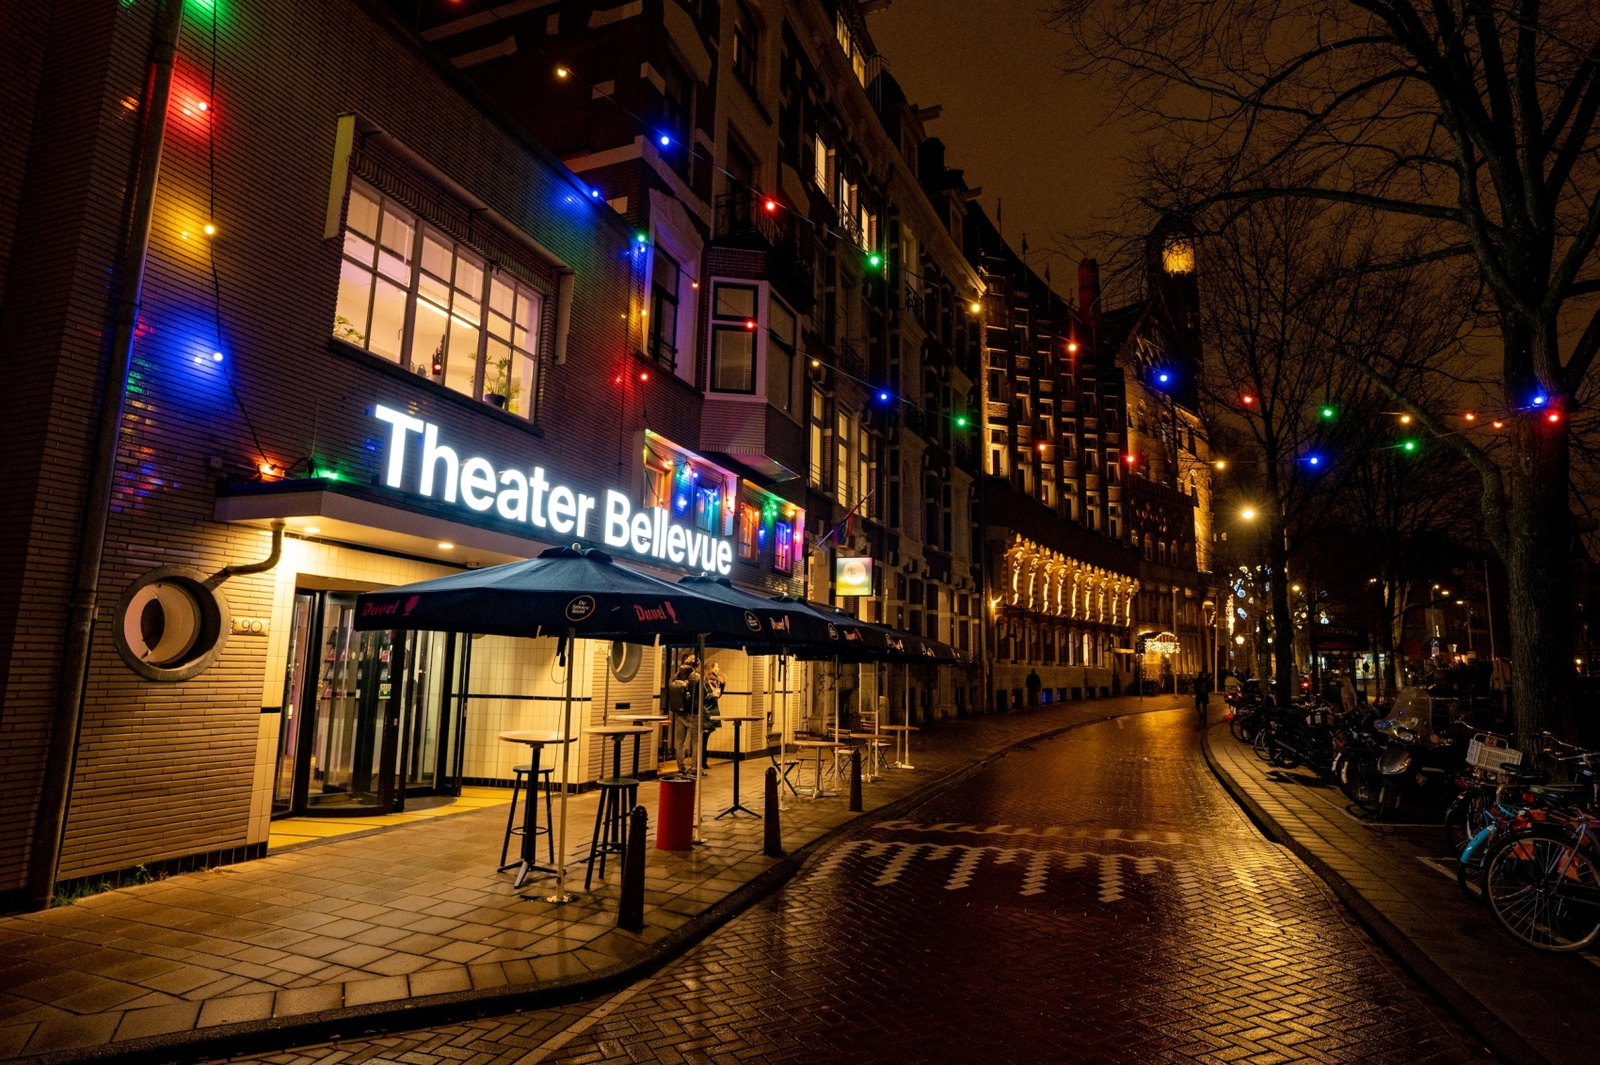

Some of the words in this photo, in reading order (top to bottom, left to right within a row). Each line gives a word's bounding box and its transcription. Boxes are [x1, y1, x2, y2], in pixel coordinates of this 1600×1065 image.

[374, 403, 595, 538] Theater
[603, 489, 733, 575] Bellevue
[361, 601, 400, 616] Duvel
[633, 604, 667, 621] Duvel
[241, 619, 263, 634] 90
